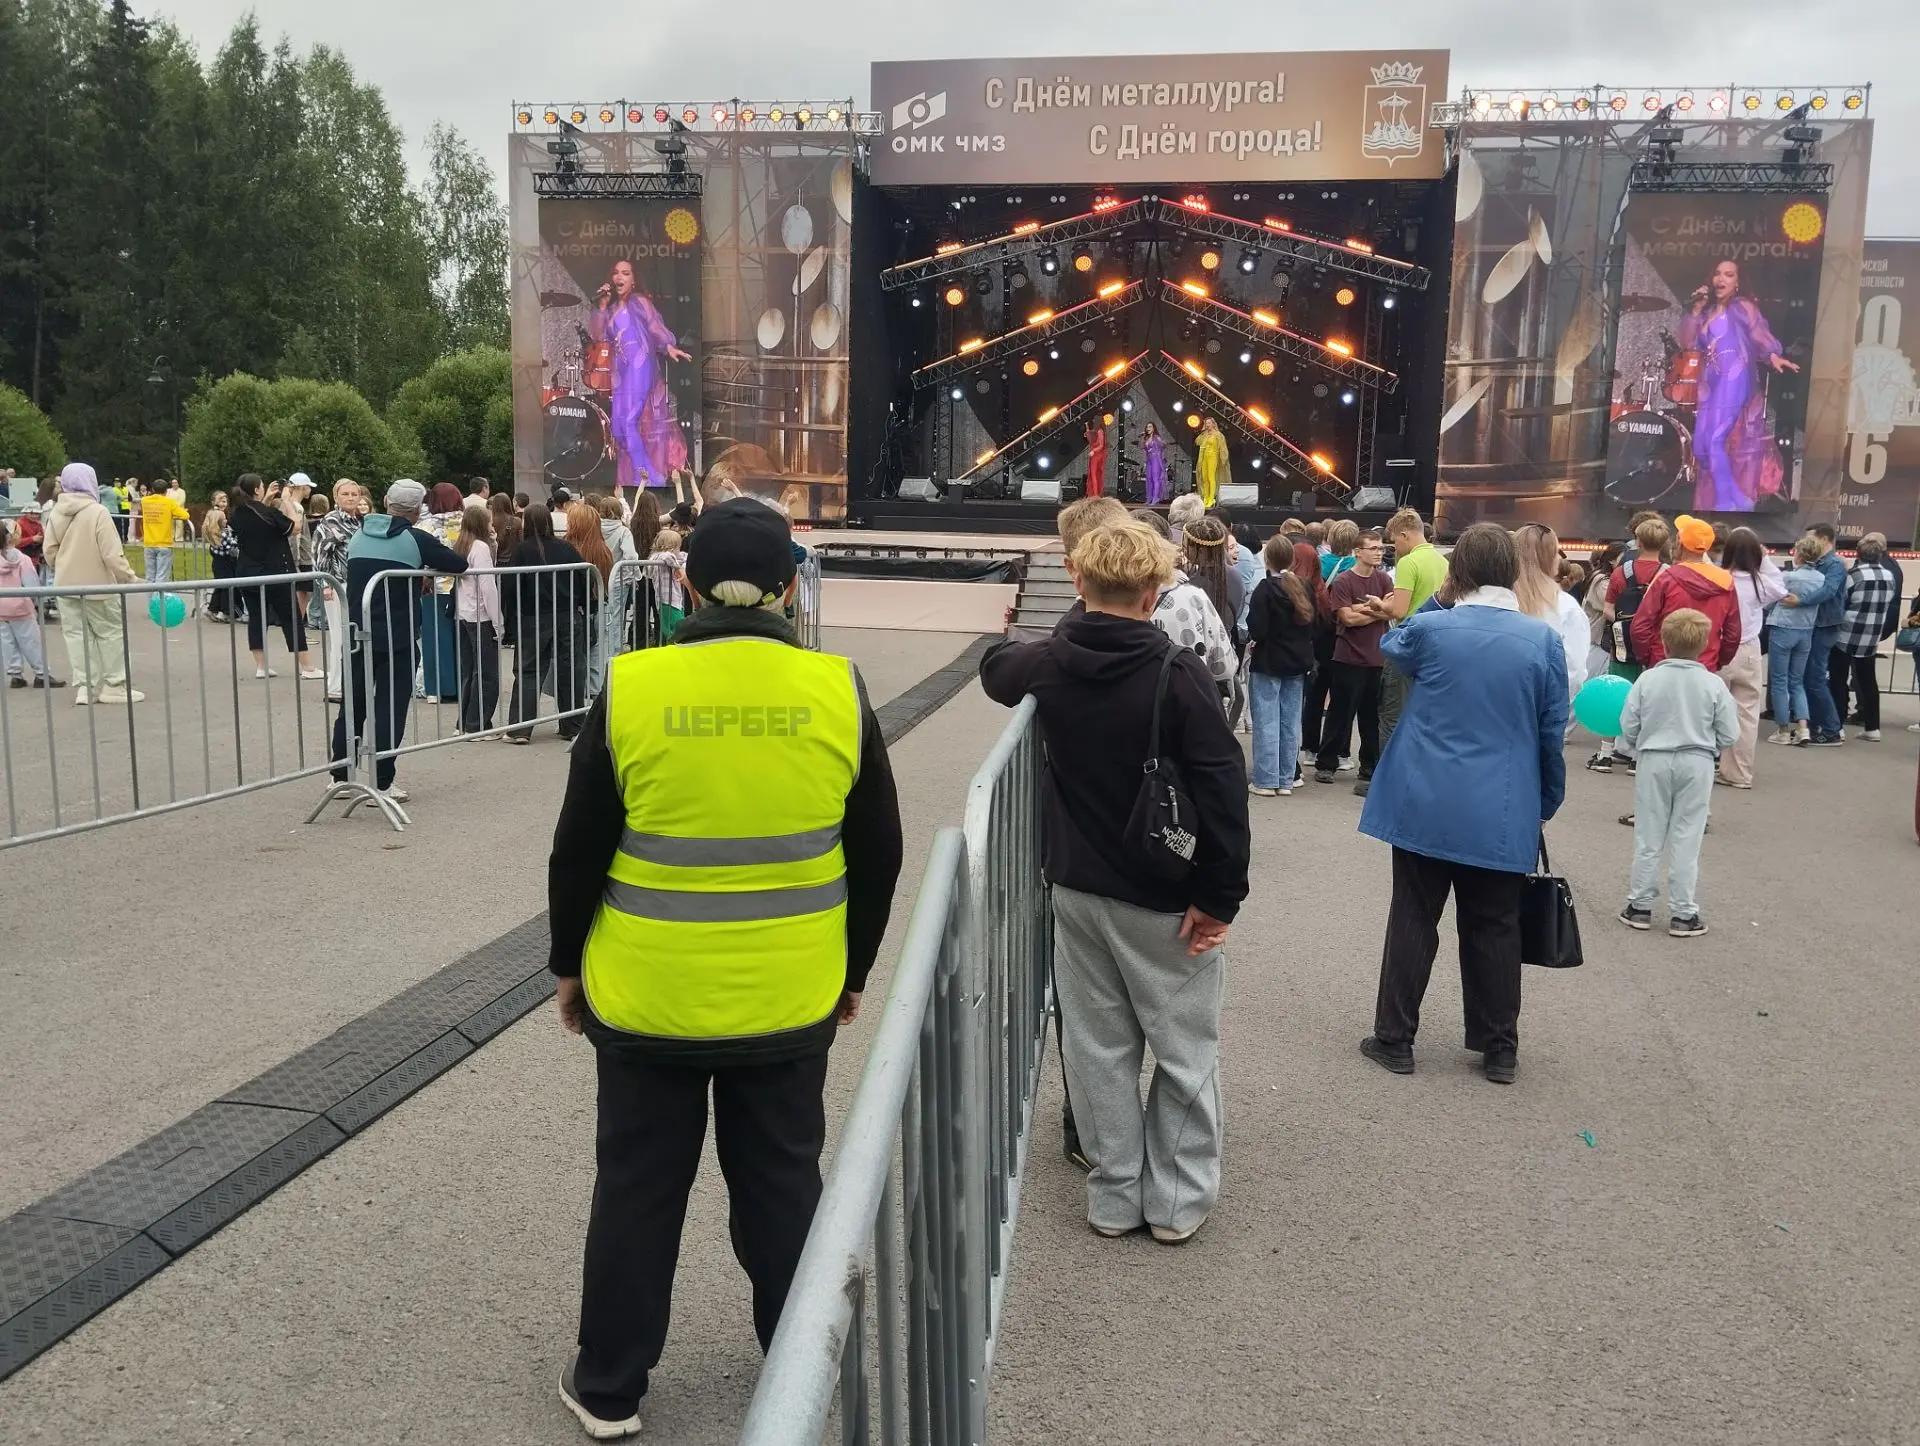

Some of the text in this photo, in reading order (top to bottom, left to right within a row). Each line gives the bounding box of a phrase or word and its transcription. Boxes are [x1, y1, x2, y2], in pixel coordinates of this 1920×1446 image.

[986, 72, 1285, 113] С Днём металлурга!
[892, 135, 1007, 153] ОМК ЧМЗ
[1089, 120, 1323, 161] С Днём города!
[579, 219, 636, 238] Днём
[1677, 216, 1745, 236] Днём
[559, 406, 587, 418] YAMAHA
[1629, 421, 1663, 435] YAMAHA
[663, 705, 812, 737] ЦЕРБЕР
[1161, 825, 1187, 848] NORTH
[1176, 826, 1192, 841] THE
[1164, 837, 1185, 855] FACE
